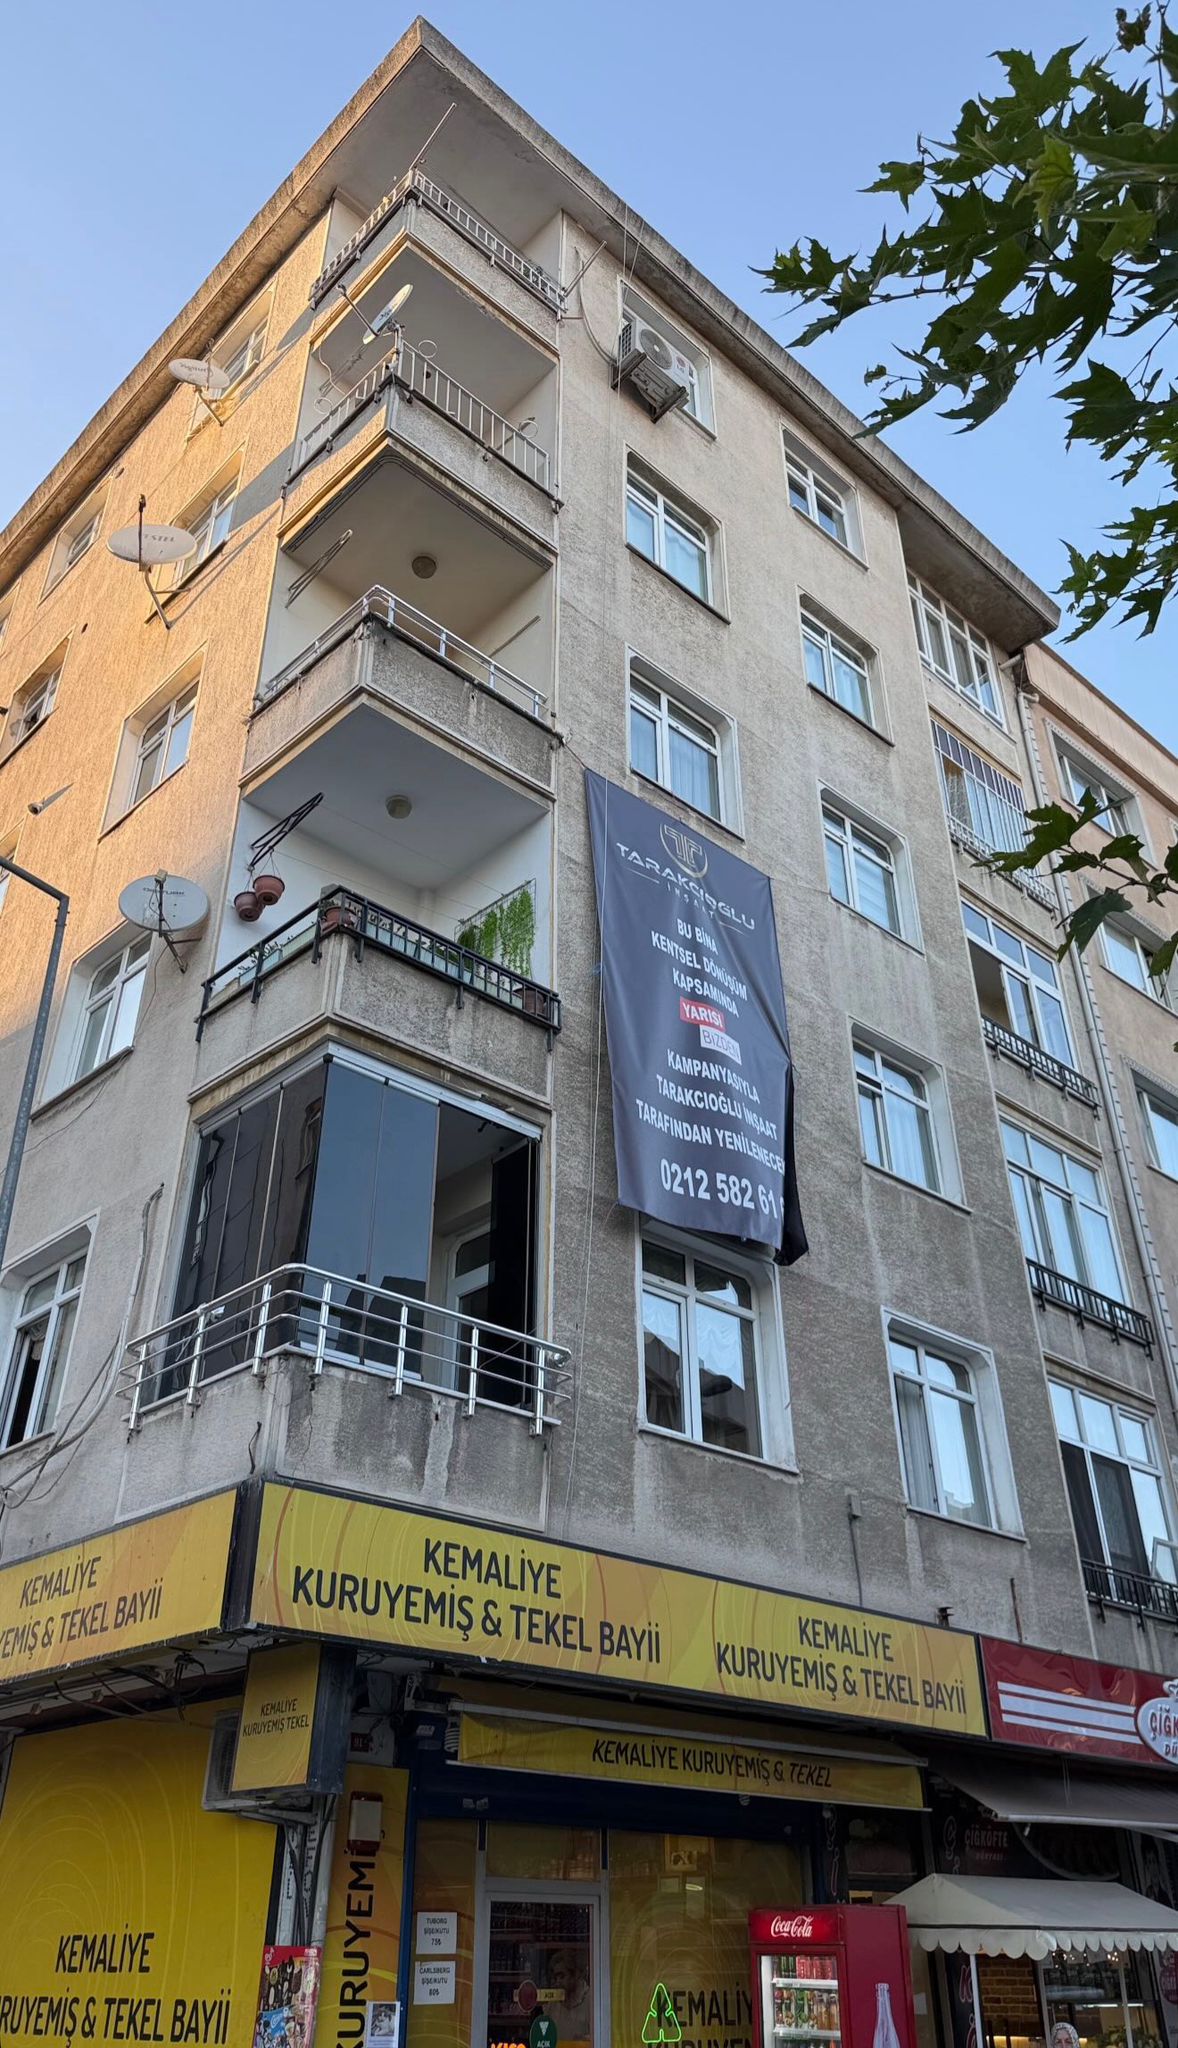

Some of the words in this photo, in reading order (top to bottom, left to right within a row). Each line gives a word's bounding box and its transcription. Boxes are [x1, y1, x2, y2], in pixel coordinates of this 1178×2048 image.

[677, 918, 692, 940] BU
[695, 926, 718, 955] BİNA
[651, 930, 701, 969] KENTSEL
[703, 956, 748, 1001] DÖNÜŞÜM
[672, 967, 739, 1018] KAPSAMINDA
[682, 1003, 724, 1028] YARISI
[667, 1049, 761, 1104] KAMPANYASIYLA
[636, 1099, 713, 1145] TARAFINDAN
[656, 1074, 743, 1119] TARAKCIOĞLU
[743, 1102, 778, 1140] İNŞAAT
[661, 1158, 711, 1200] 0212
[716, 1172, 755, 1209] 582
[758, 1184, 778, 1219] 61
[20, 1555, 101, 1609] KEMALİYE
[424, 1537, 562, 1599] KEMALİYE
[41, 1616, 55, 1648] &
[59, 1601, 109, 1644] TEKEL
[113, 1577, 163, 1630] BAYİİ
[292, 1566, 474, 1641] KURUYEMİŞ
[481, 1599, 502, 1637] &
[510, 1604, 593, 1653] TEKEL
[600, 1621, 661, 1663] BAYİİ
[798, 1615, 894, 1662] KEMALİYE
[716, 1641, 838, 1700] KURUYEMİŞ
[843, 1664, 858, 1696] &
[860, 1668, 919, 1706] TEKEL
[922, 1678, 967, 1714] BAYİİ
[243, 1715, 286, 1737] KURUYEMİŞ
[287, 1714, 309, 1730] TEKEL
[592, 1739, 678, 1770] KEMALİYE
[682, 1749, 770, 1786] KURUYEMİŞ
[773, 1761, 785, 1782] &
[790, 1762, 832, 1788] TEKEL
[426, 1917, 448, 1925] TUBORG
[55, 1923, 155, 1973] KEMALİYE
[419, 1967, 450, 1975] CARLSBERG
[0, 1987, 80, 2048] RUYEMİŞ
[81, 1996, 97, 2039] &
[103, 1998, 164, 2042] TEKEL
[170, 1988, 232, 2045] BAYİİ
